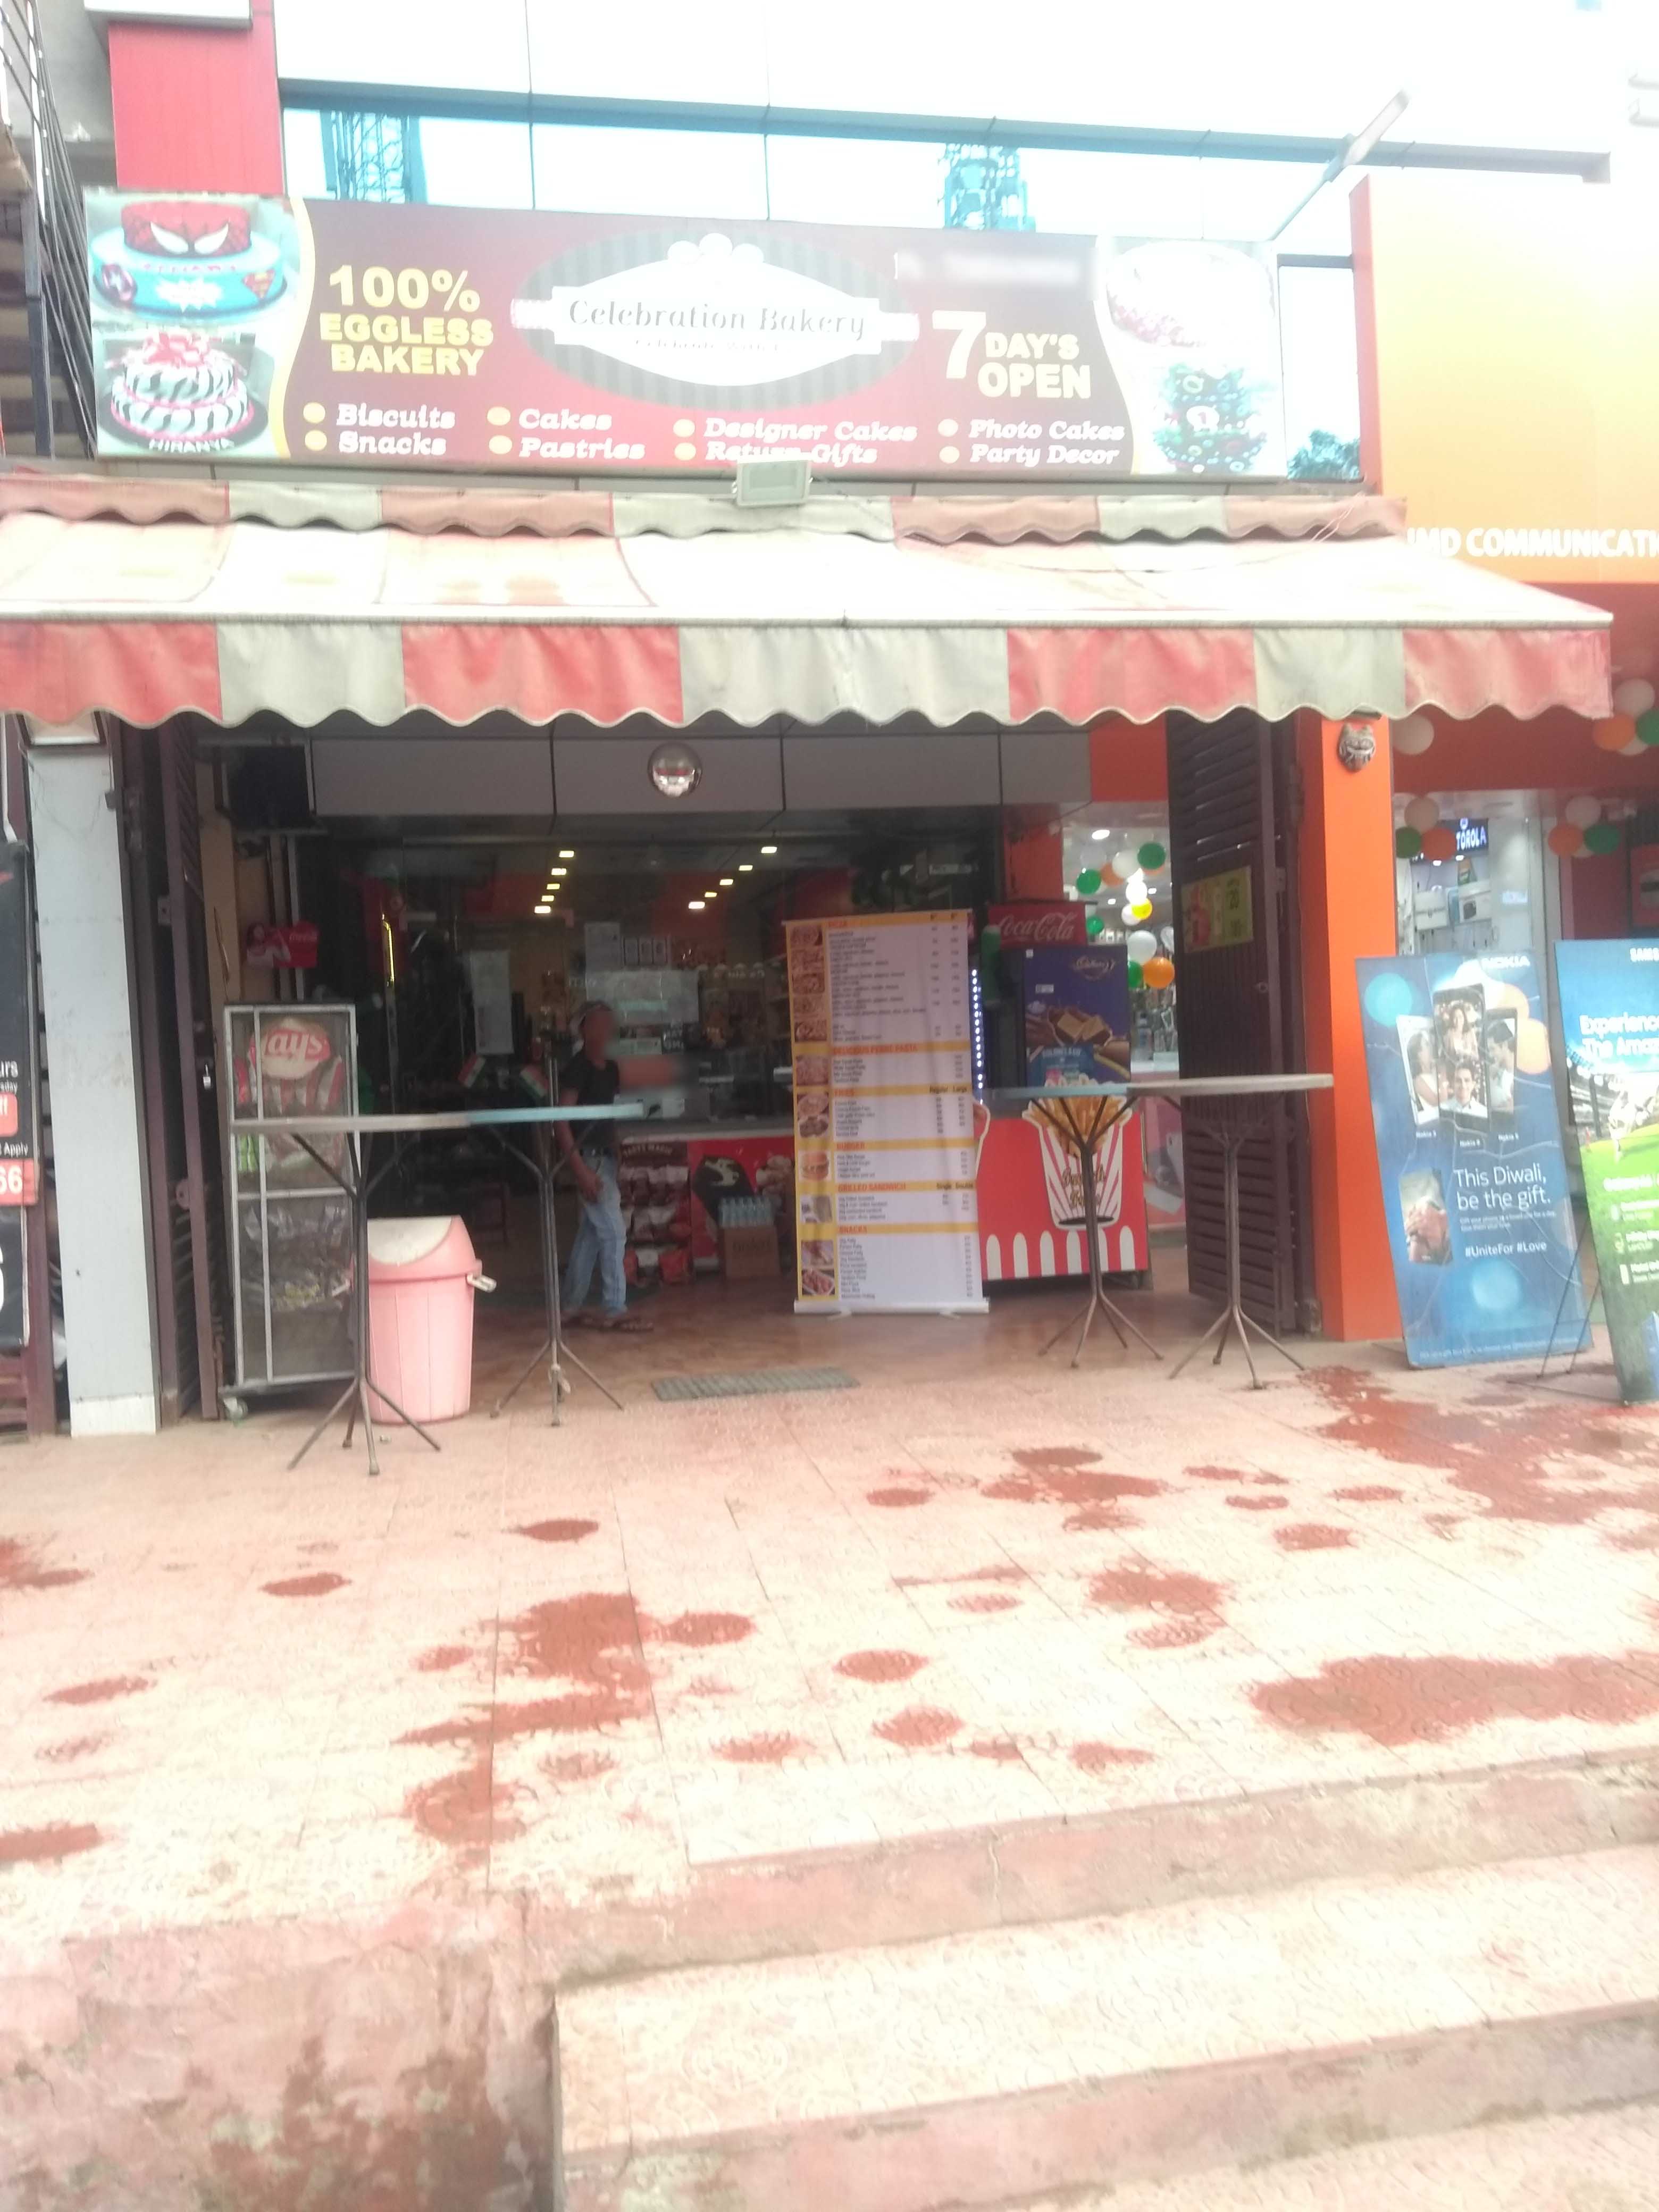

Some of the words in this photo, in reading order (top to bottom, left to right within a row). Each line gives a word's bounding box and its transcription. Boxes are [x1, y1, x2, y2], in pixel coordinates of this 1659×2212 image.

[329, 264, 480, 313] 100%
[320, 313, 493, 346] EGGLESS
[569, 299, 745, 331] Celebration
[759, 307, 865, 341] Bakery
[932, 310, 986, 379] 7
[985, 333, 1079, 360] DAY'S
[331, 345, 484, 377] BAKERY
[978, 362, 1091, 399] OPEN
[336, 403, 455, 429] Biscuits
[518, 409, 612, 430] Cakes
[338, 431, 447, 456] Snacks
[704, 418, 827, 443] Designer
[834, 421, 918, 441] Cakes
[969, 420, 1043, 439] Photo
[1049, 421, 1126, 441] Cakes
[518, 437, 646, 459] Pastries
[970, 445, 1040, 467] Party
[1048, 445, 1120, 464] Decor
[1465, 528, 1659, 557] COMMUNICATI
[4, 1142, 29, 1158] Apply
[1454, 1168, 1489, 1187] This
[1493, 1162, 1546, 1185] Diwali,
[1456, 1191, 1479, 1210] be
[1484, 1188, 1512, 1209] the
[1518, 1185, 1551, 1211] gift.
[1465, 1243, 1514, 1258] #UniteFor
[1516, 1242, 1547, 1253] #Love
